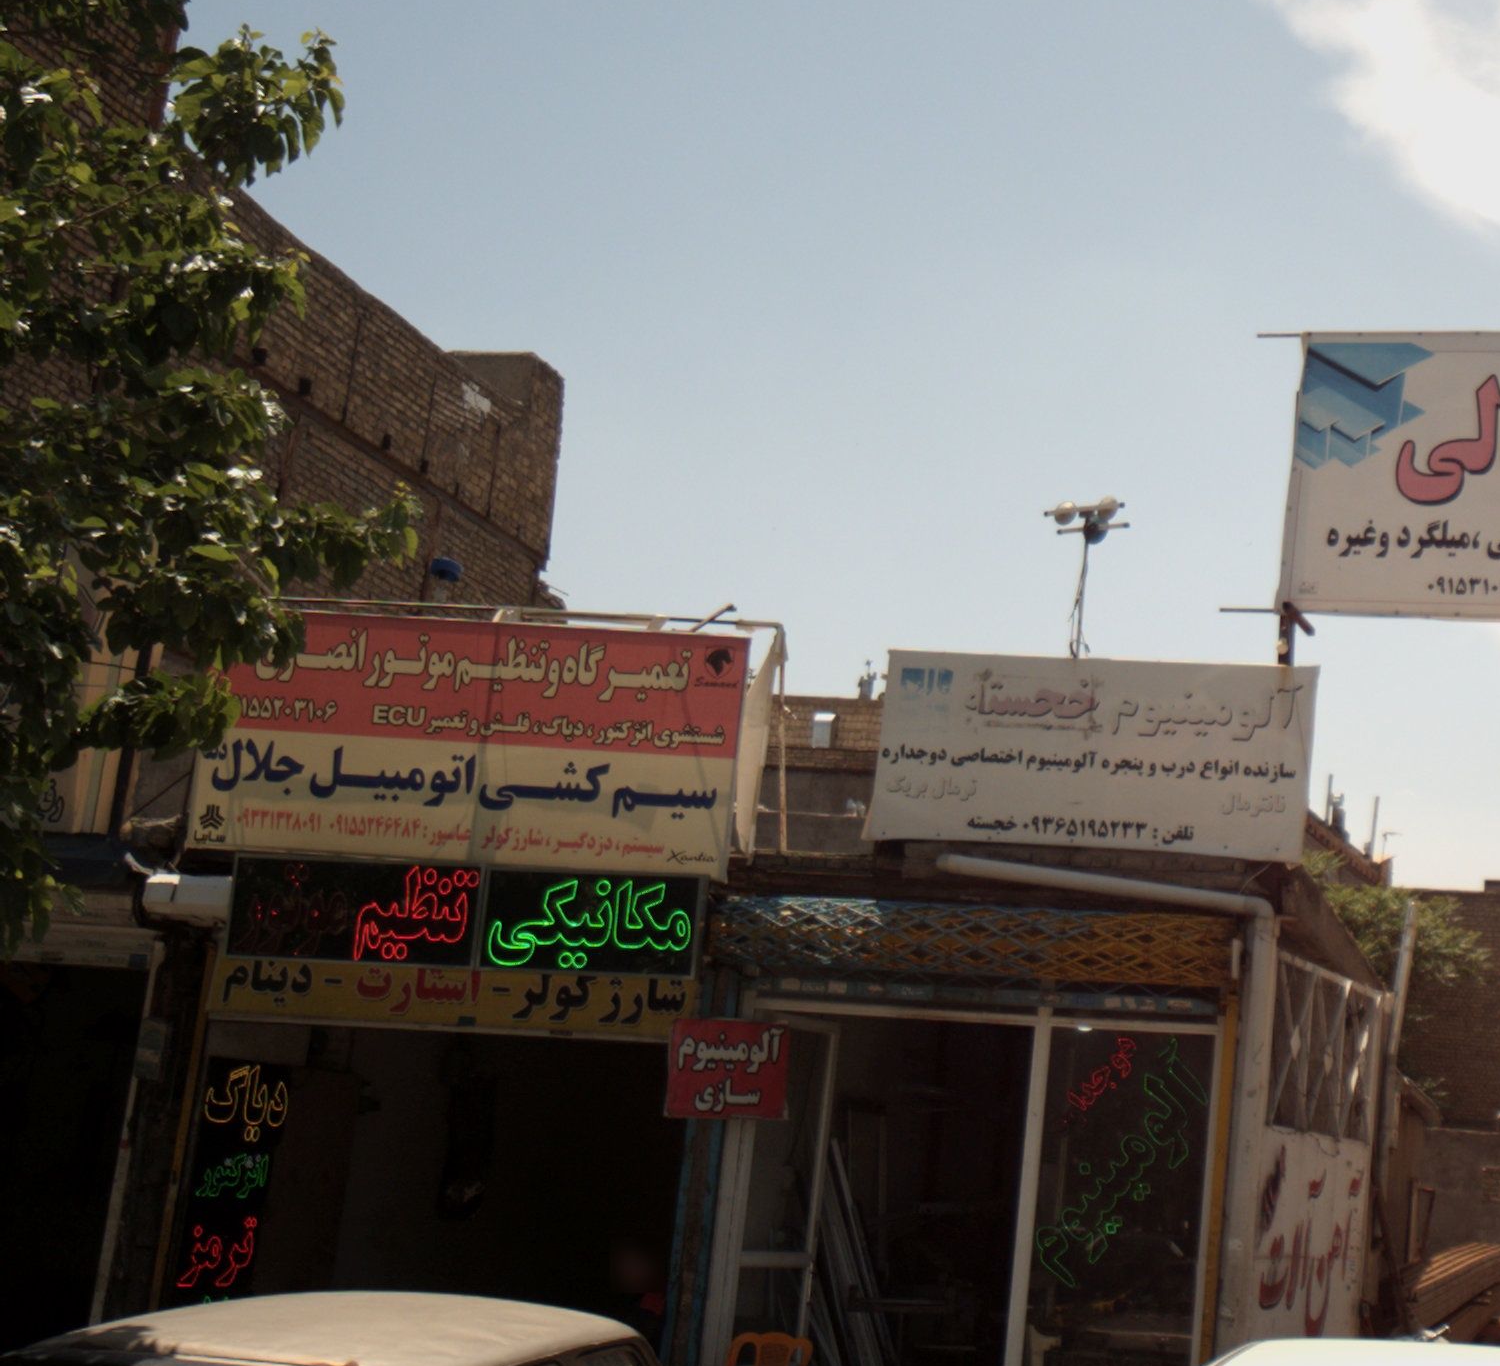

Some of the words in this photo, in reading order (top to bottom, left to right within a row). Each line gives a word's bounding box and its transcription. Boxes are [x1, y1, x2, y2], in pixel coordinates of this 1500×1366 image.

[256, 628, 368, 682] انصری
[363, 633, 456, 690] موتور
[236, 695, 339, 724] ۱۵۵۲۰۳۱۰۶
[372, 705, 427, 727] ECU
[425, 711, 469, 734] تعمیر
[1112, 684, 1304, 741] آلومینیوم
[212, 738, 304, 795] جلال
[310, 746, 476, 807] اتومبیل
[950, 747, 1024, 767] اختصاصی
[1026, 751, 1098, 773] آلومینیوم
[1101, 756, 1144, 776] پنجره
[1147, 761, 1157, 777] و
[1161, 760, 1196, 779] درب
[1199, 760, 1240, 780] انواع
[1243, 762, 1297, 783] سازنده
[479, 761, 610, 810] کشی
[612, 784, 718, 820] سیم
[967, 816, 1017, 833] خجسته
[1023, 816, 1147, 840] ۰۹۳۶۵۱۹۵۲۳۳
[353, 864, 481, 961] تنظیم
[487, 878, 692, 968] مکانیکی
[221, 960, 312, 1006] دینام
[356, 966, 481, 1015] استارت
[512, 974, 599, 1023] کولر
[598, 977, 686, 1024] شارژ
[677, 1026, 785, 1074] آلومینیوم
[204, 1064, 289, 1142] دیاگ
[694, 1076, 762, 1114] سازی
[194, 1151, 270, 1199] انژکتور
[1036, 1035, 1209, 1289] آلومینیوم
[175, 1216, 258, 1289] ترمز
